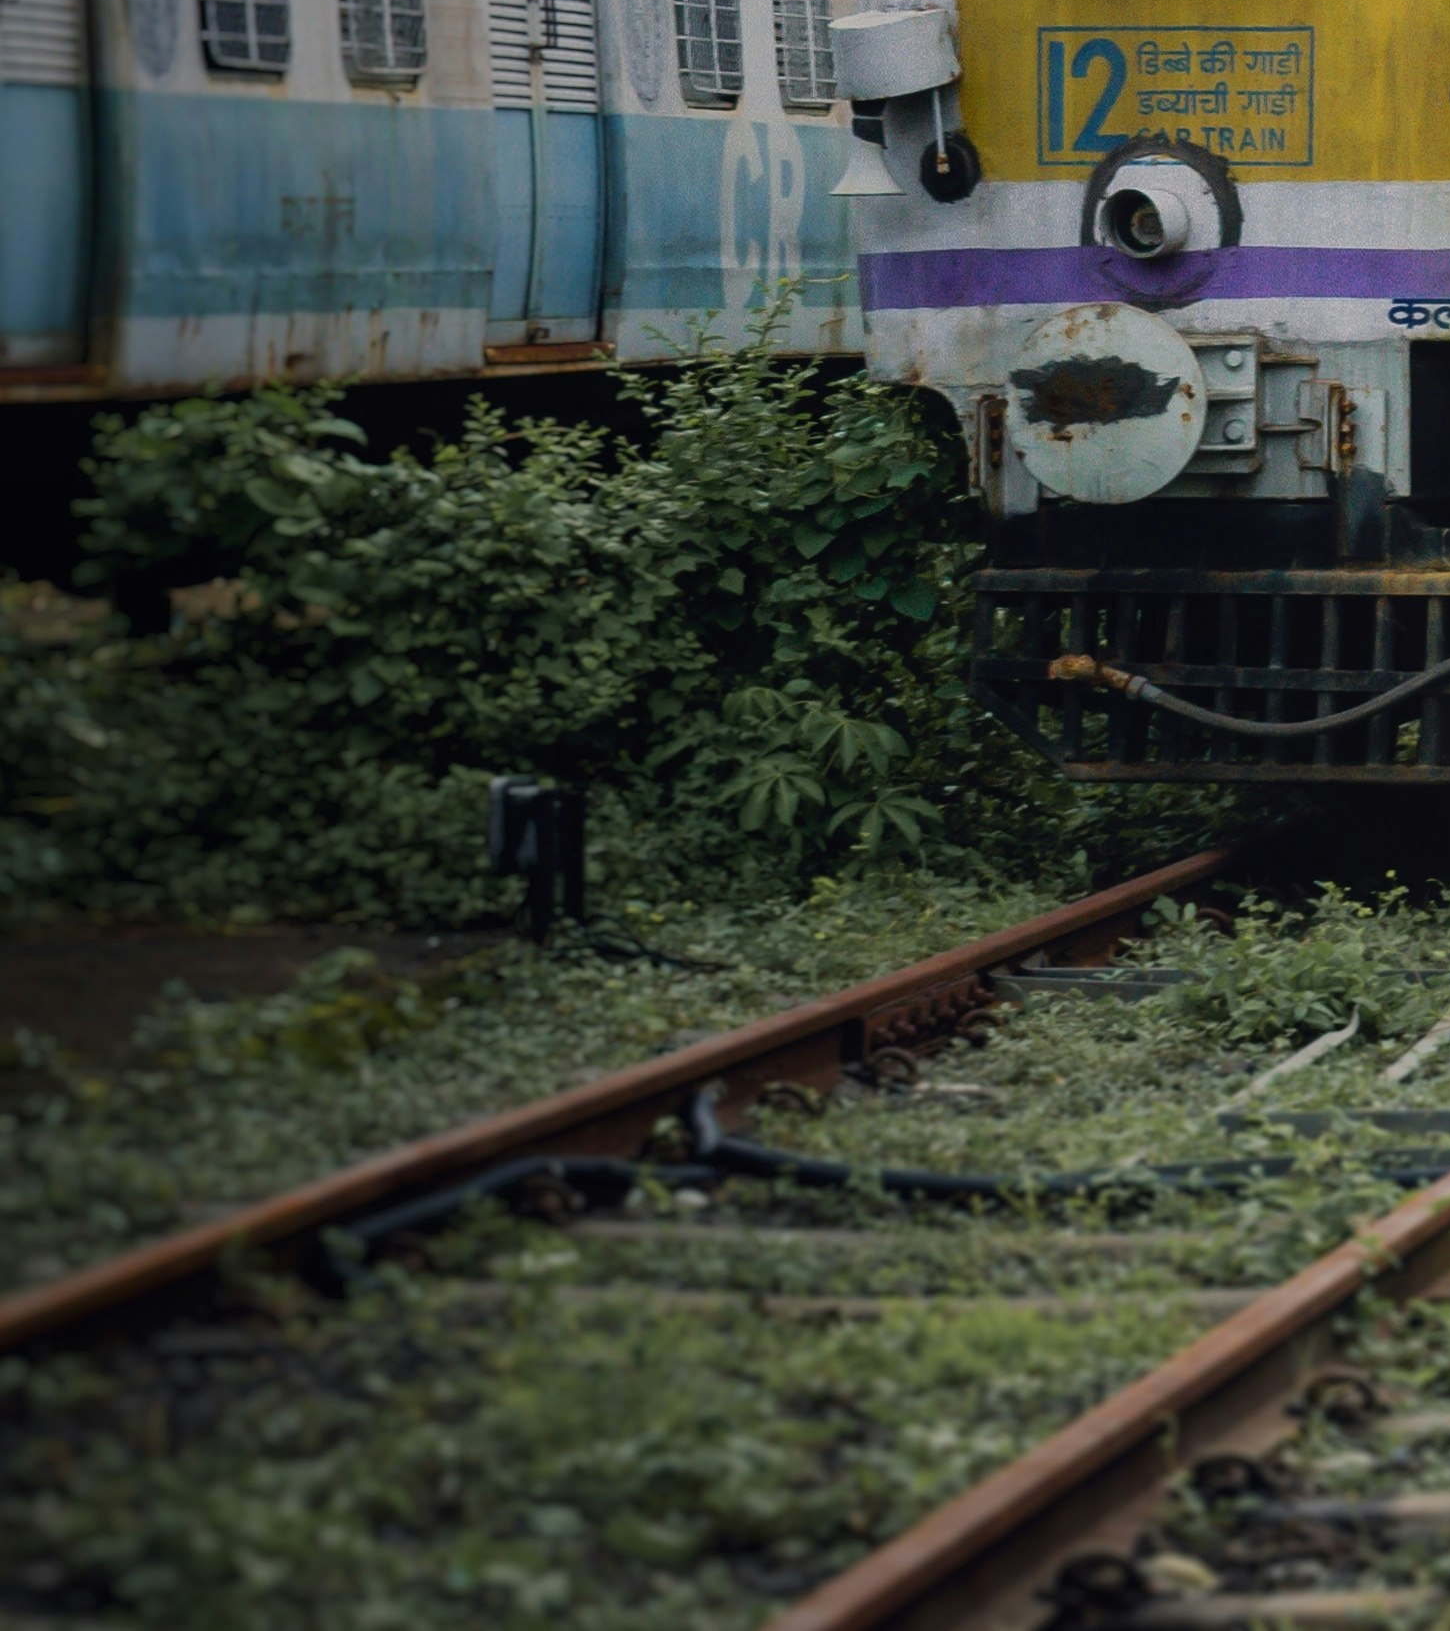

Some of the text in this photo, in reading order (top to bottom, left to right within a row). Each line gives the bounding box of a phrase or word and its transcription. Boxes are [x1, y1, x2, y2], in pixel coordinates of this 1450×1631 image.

[1196, 40, 1236, 75] की
[1048, 38, 1129, 153] 12
[1200, 126, 1286, 153] TRAIN
